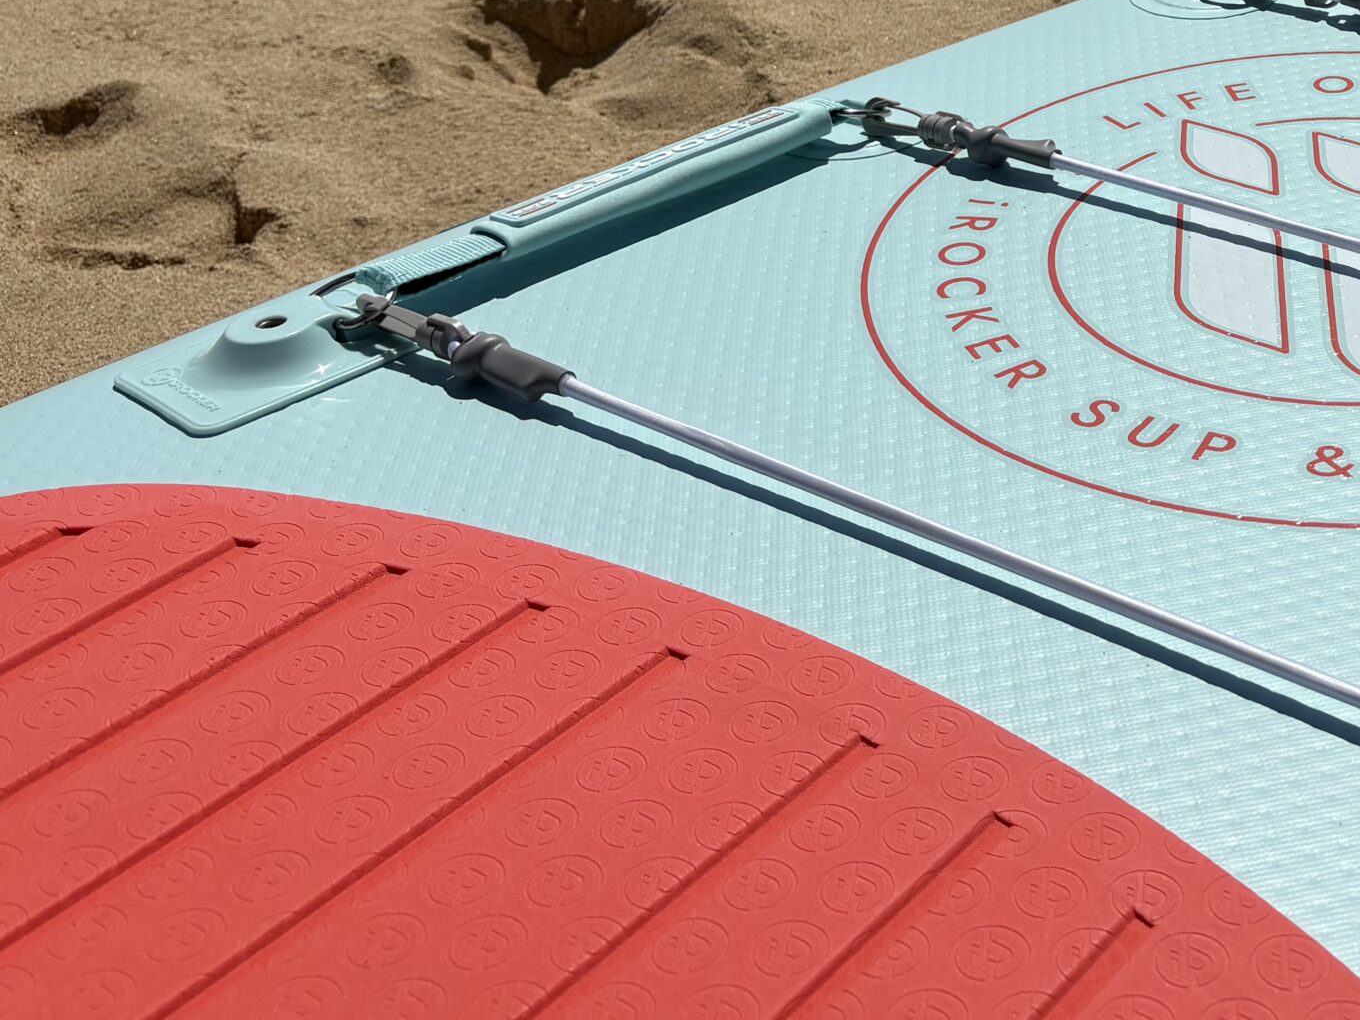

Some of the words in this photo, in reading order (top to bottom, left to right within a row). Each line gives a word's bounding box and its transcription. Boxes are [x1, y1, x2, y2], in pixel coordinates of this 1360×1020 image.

[1102, 82, 1259, 131] LIFE
[936, 197, 1049, 389] iROCKER
[1070, 400, 1237, 461] SUP
[1306, 445, 1354, 478] &
